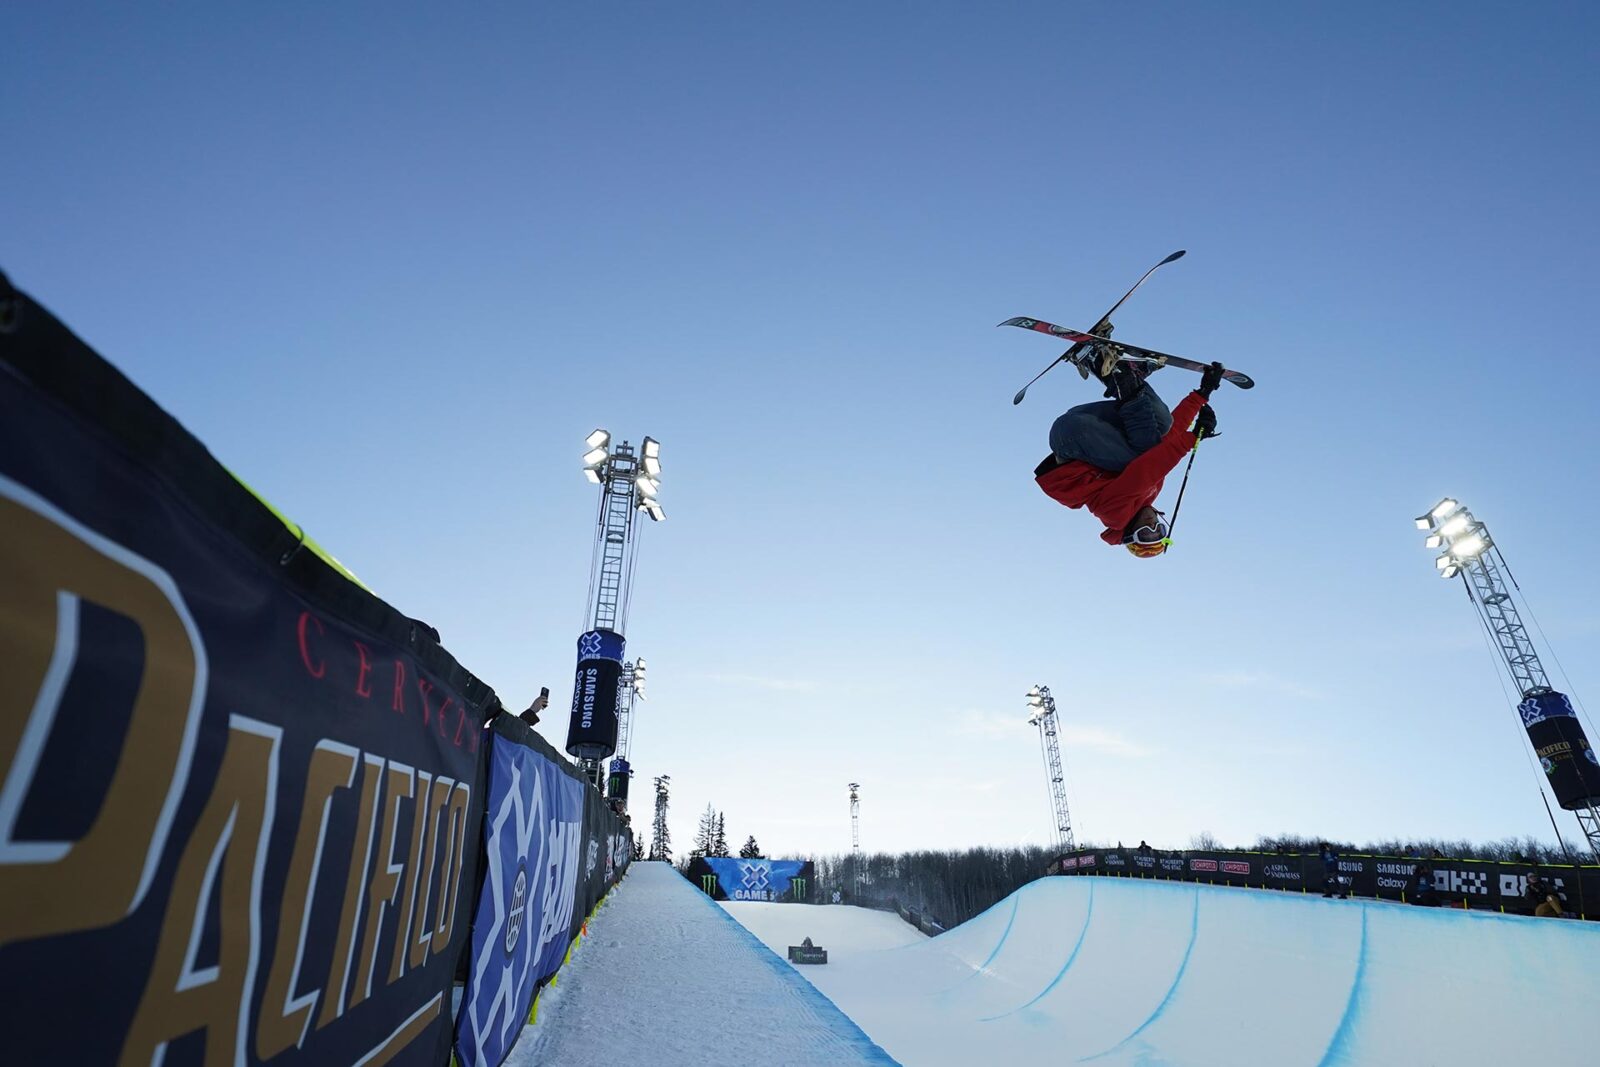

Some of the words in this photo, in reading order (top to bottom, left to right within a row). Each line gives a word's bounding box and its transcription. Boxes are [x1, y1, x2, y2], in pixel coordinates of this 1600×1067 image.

[572, 670, 584, 713] Galaxy
[582, 668, 598, 729] SAMSUNG
[1225, 863, 1248, 872] CHIPOTLE
[1270, 864, 1289, 872] ASPEN
[1376, 863, 1415, 876] SAMSUN
[1270, 871, 1301, 880] SNOWMASS
[1433, 869, 1488, 895] OKX
[1377, 876, 1408, 890] Galaxy
